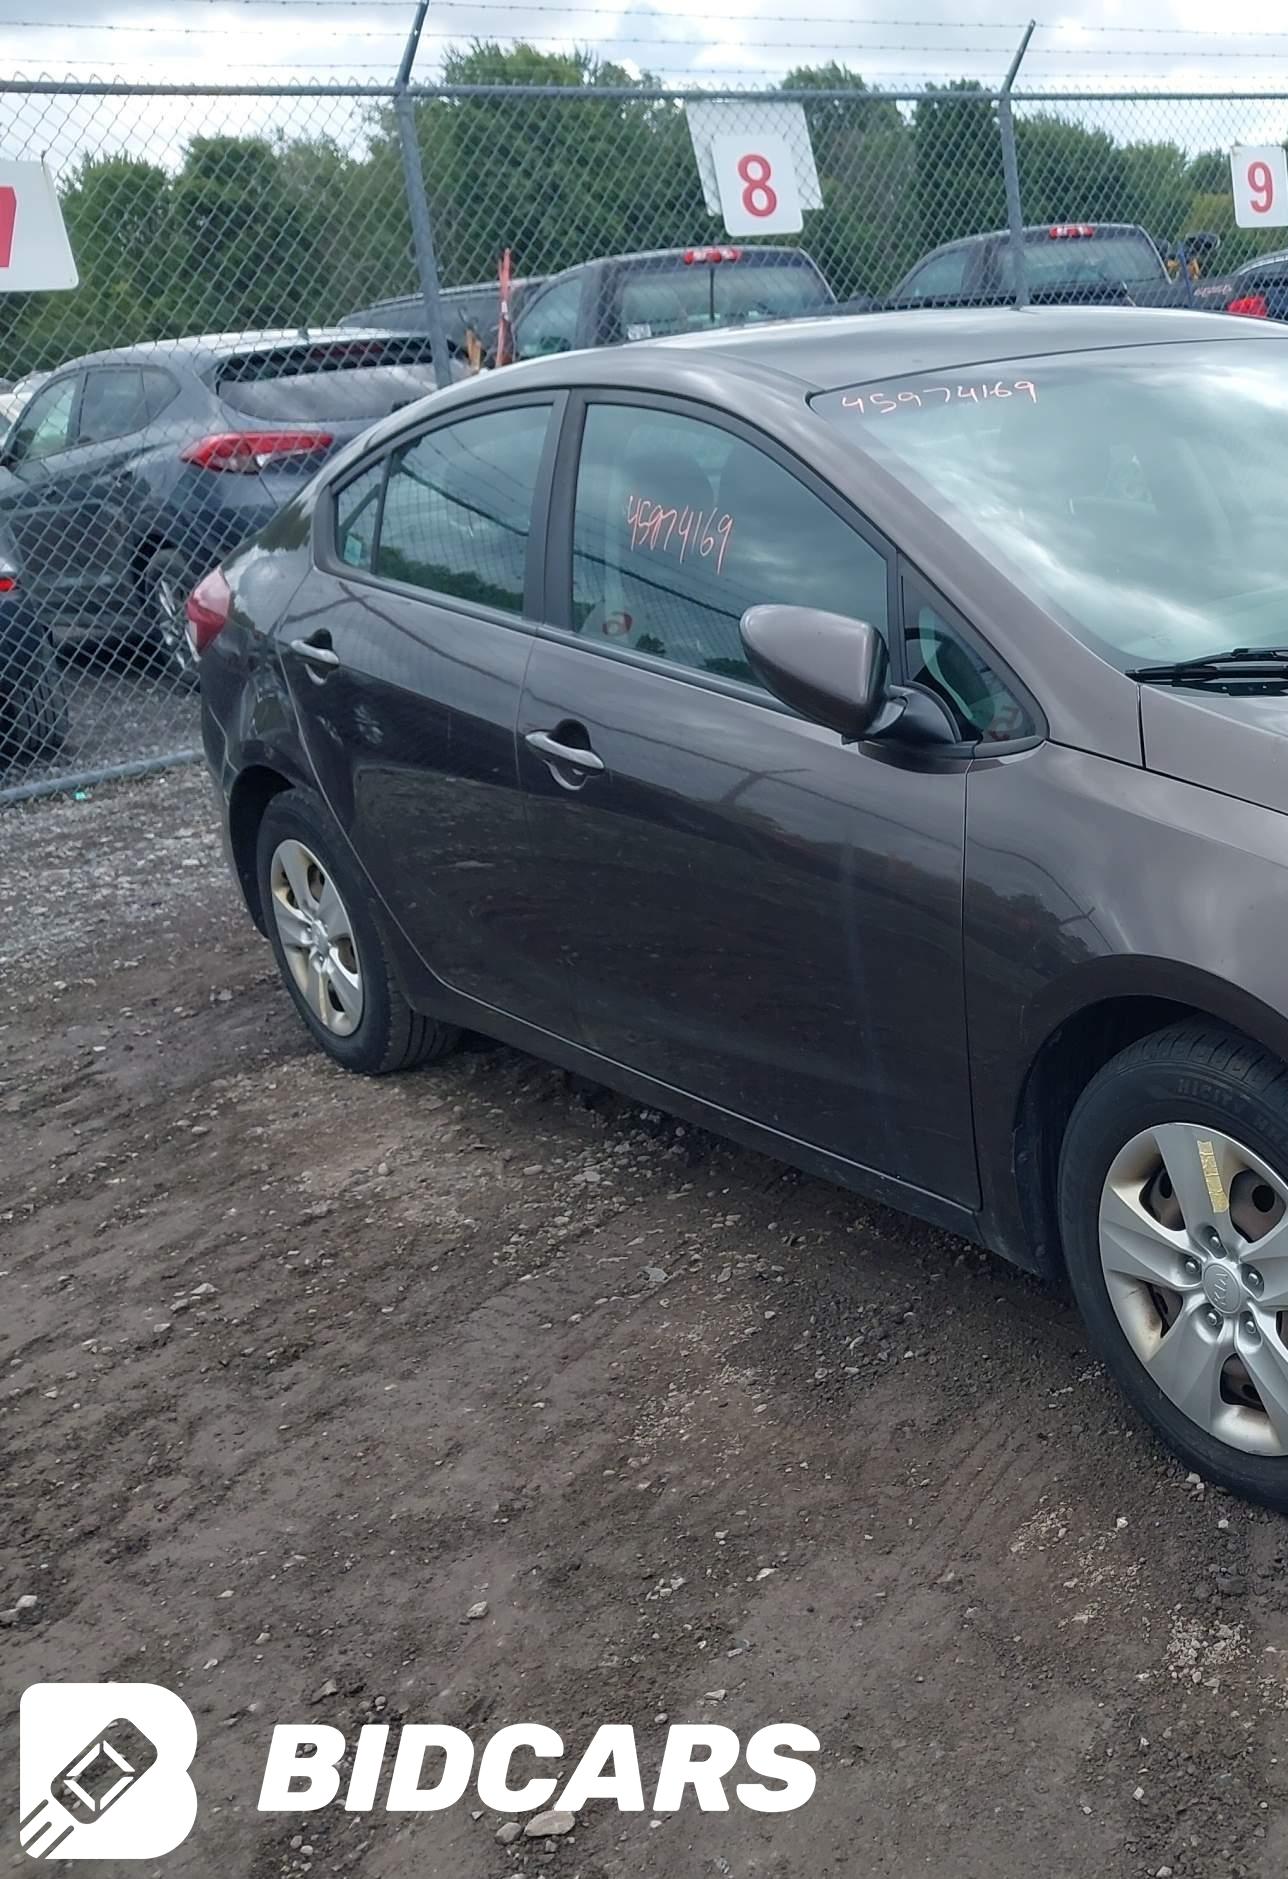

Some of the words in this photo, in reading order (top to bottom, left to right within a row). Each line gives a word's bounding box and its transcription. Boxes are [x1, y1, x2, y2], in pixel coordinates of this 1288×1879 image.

[737, 153, 778, 218] 8
[1247, 161, 1274, 214] 9
[841, 380, 1038, 415] 45974169
[626, 494, 735, 576] 45974169
